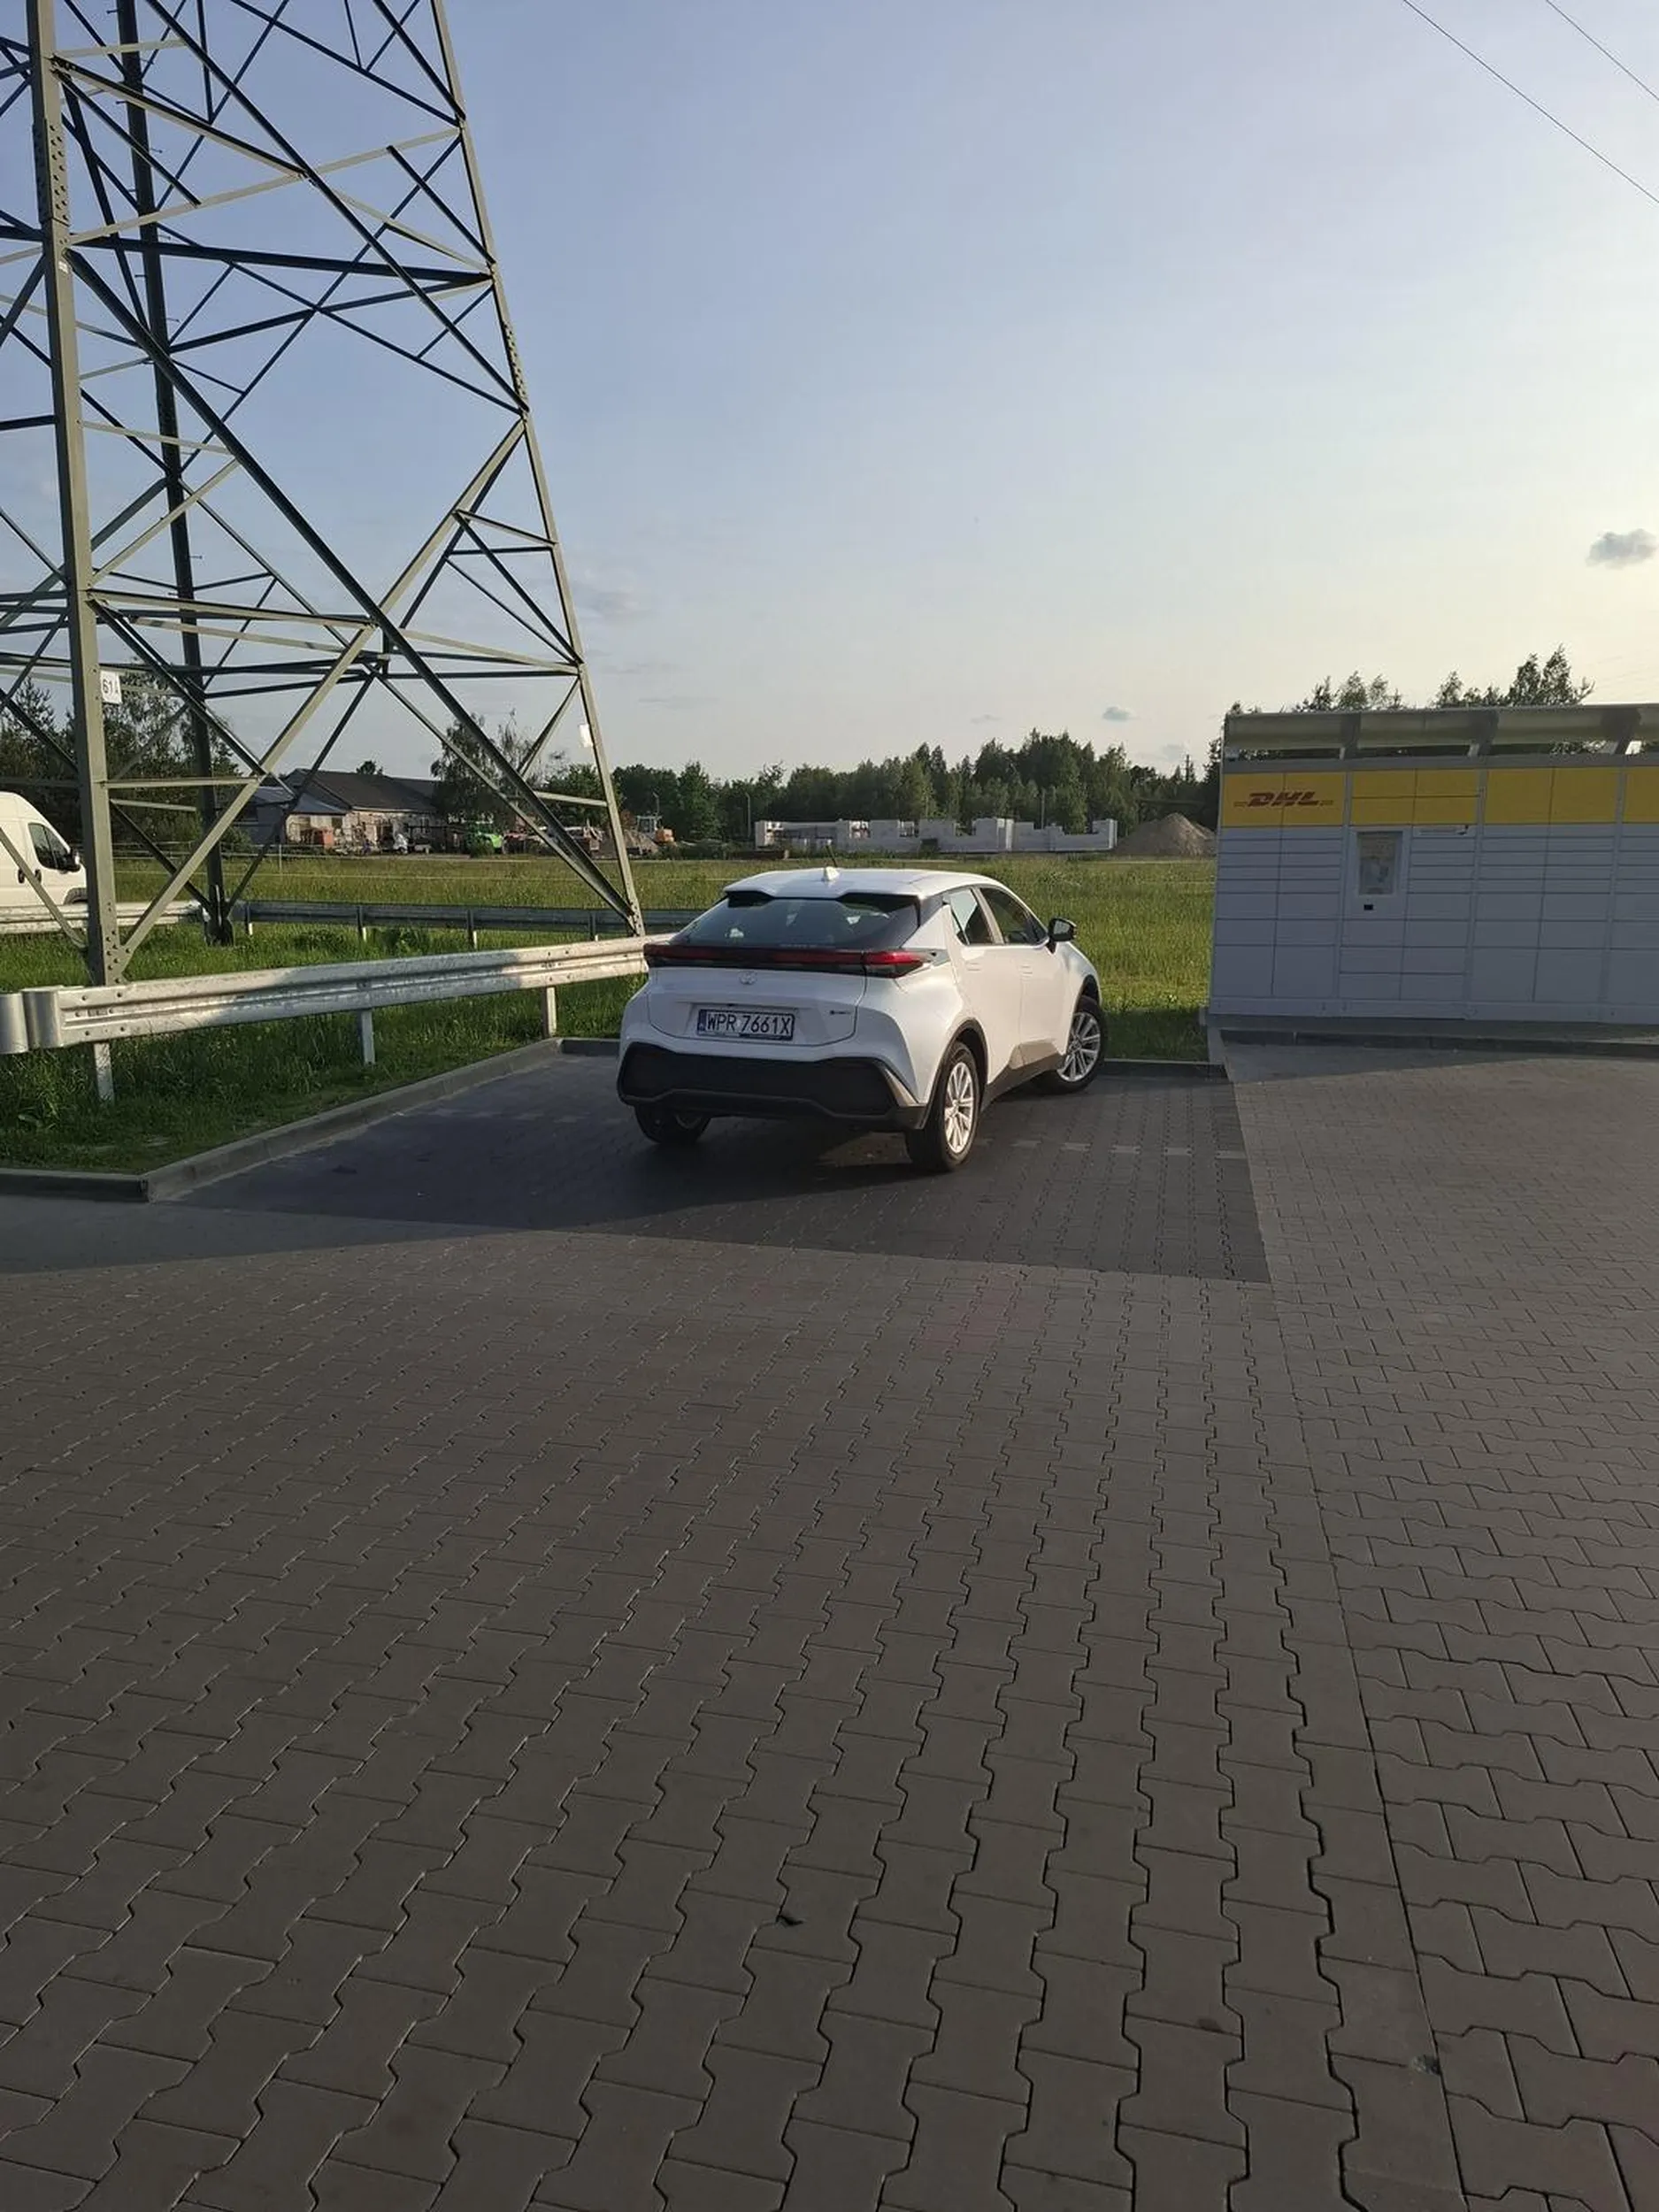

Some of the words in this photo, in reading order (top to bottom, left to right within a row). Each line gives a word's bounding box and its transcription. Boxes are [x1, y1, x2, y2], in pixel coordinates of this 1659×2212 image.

[1247, 791, 1318, 807] DHL
[707, 1013, 737, 1032] WPR
[741, 1015, 791, 1034] 7661X
